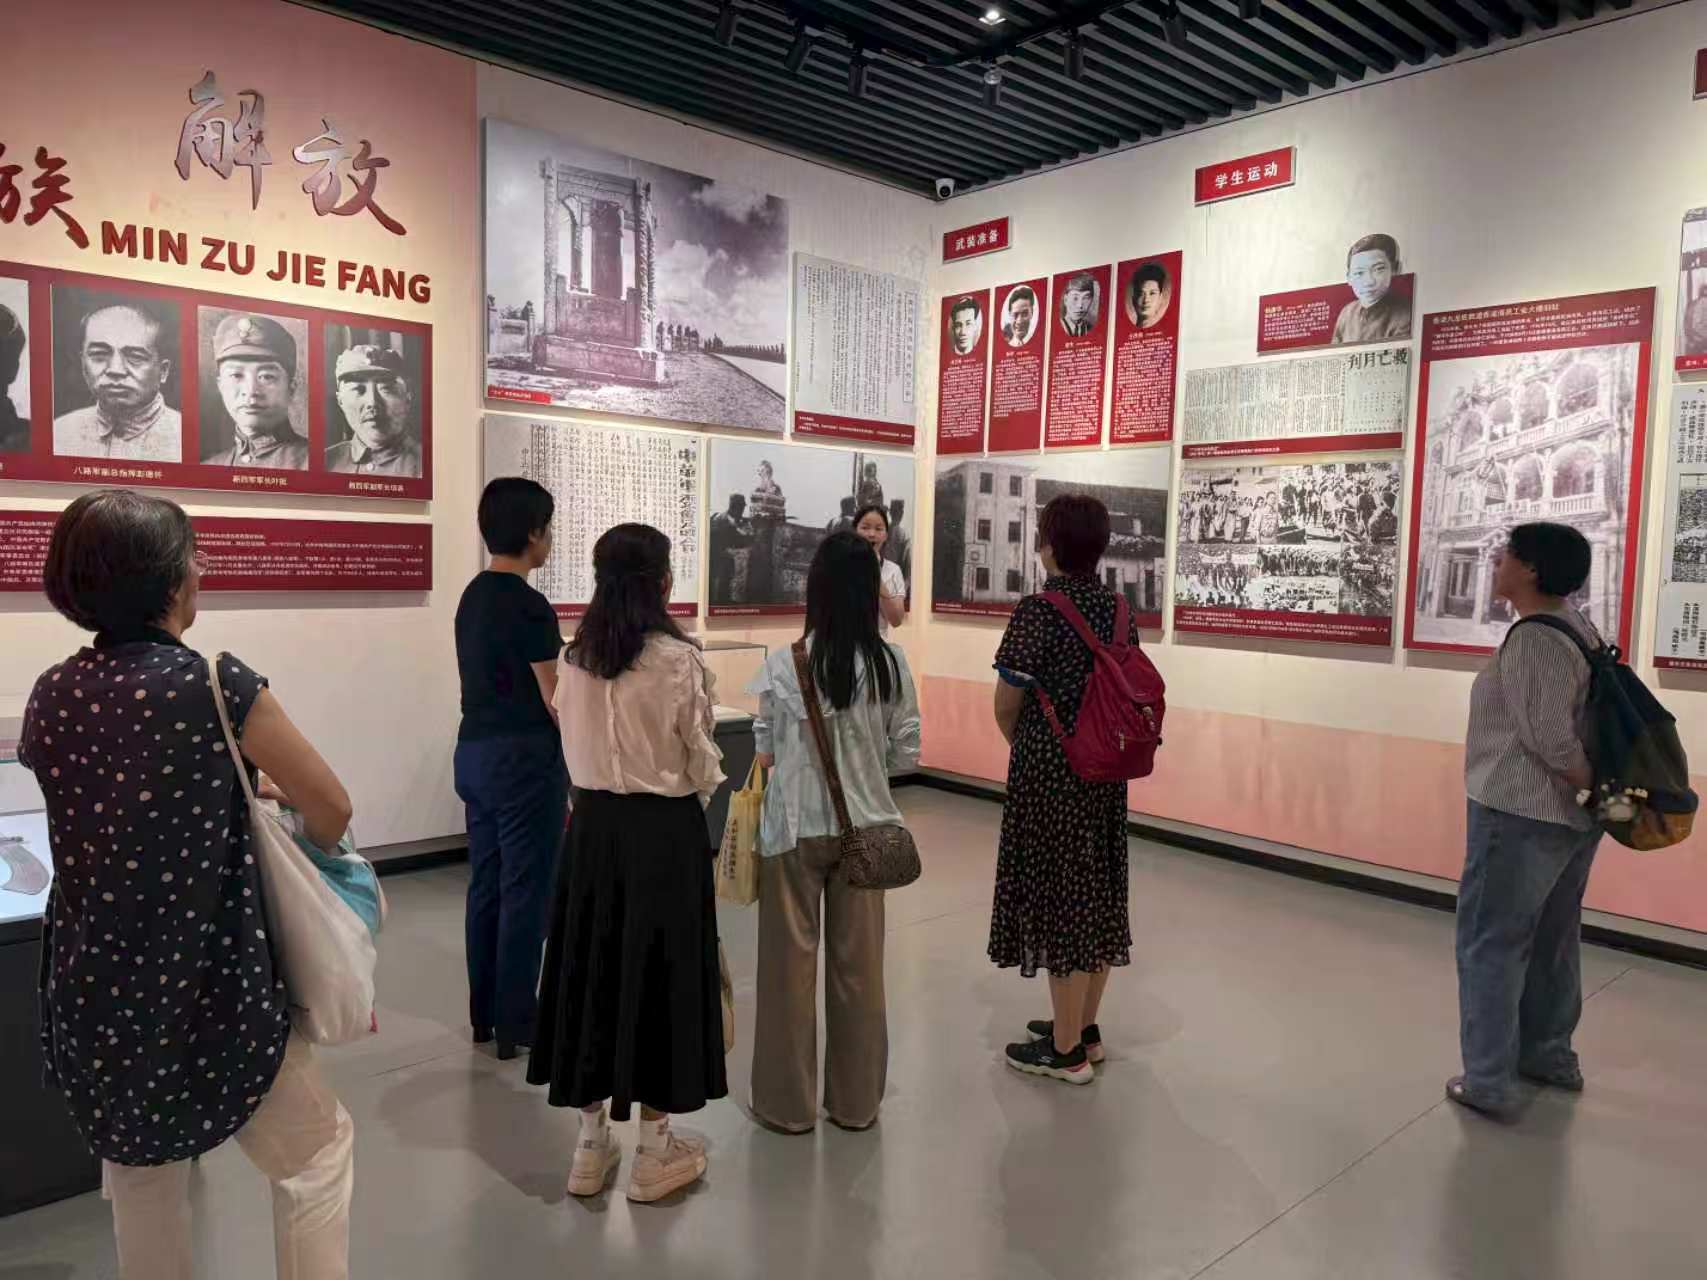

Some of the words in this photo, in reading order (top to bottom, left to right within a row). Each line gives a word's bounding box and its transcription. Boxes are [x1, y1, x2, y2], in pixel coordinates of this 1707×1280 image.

[174, 69, 407, 236] 解放
[1215, 161, 1278, 189] 学生运动
[0, 141, 90, 250] 族
[101, 220, 188, 265] MIN
[200, 236, 255, 276] ZU
[266, 250, 326, 288] JIE
[337, 260, 431, 304] FANG
[955, 228, 999, 252] 武装准备
